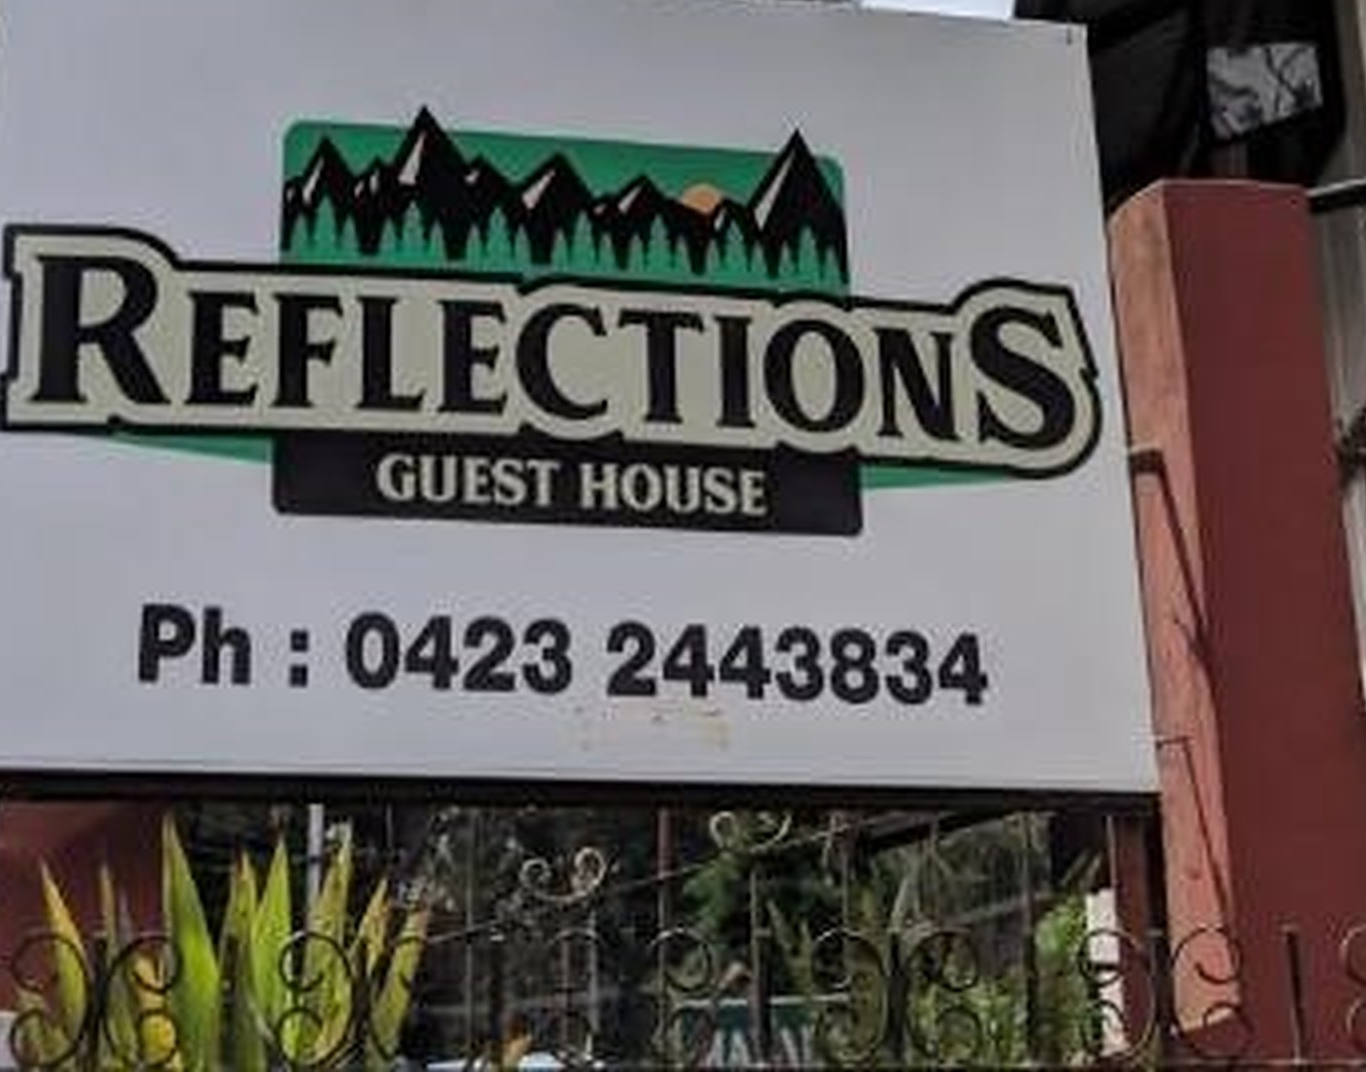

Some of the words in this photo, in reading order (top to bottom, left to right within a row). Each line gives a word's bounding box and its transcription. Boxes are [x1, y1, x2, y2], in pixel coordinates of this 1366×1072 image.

[28, 253, 1076, 452] REFLECTIONS
[376, 453, 560, 507] GUEST
[580, 462, 767, 516] HOUSE
[137, 602, 252, 686] Ph
[343, 611, 573, 696] 0423
[605, 619, 989, 708] 2443834
